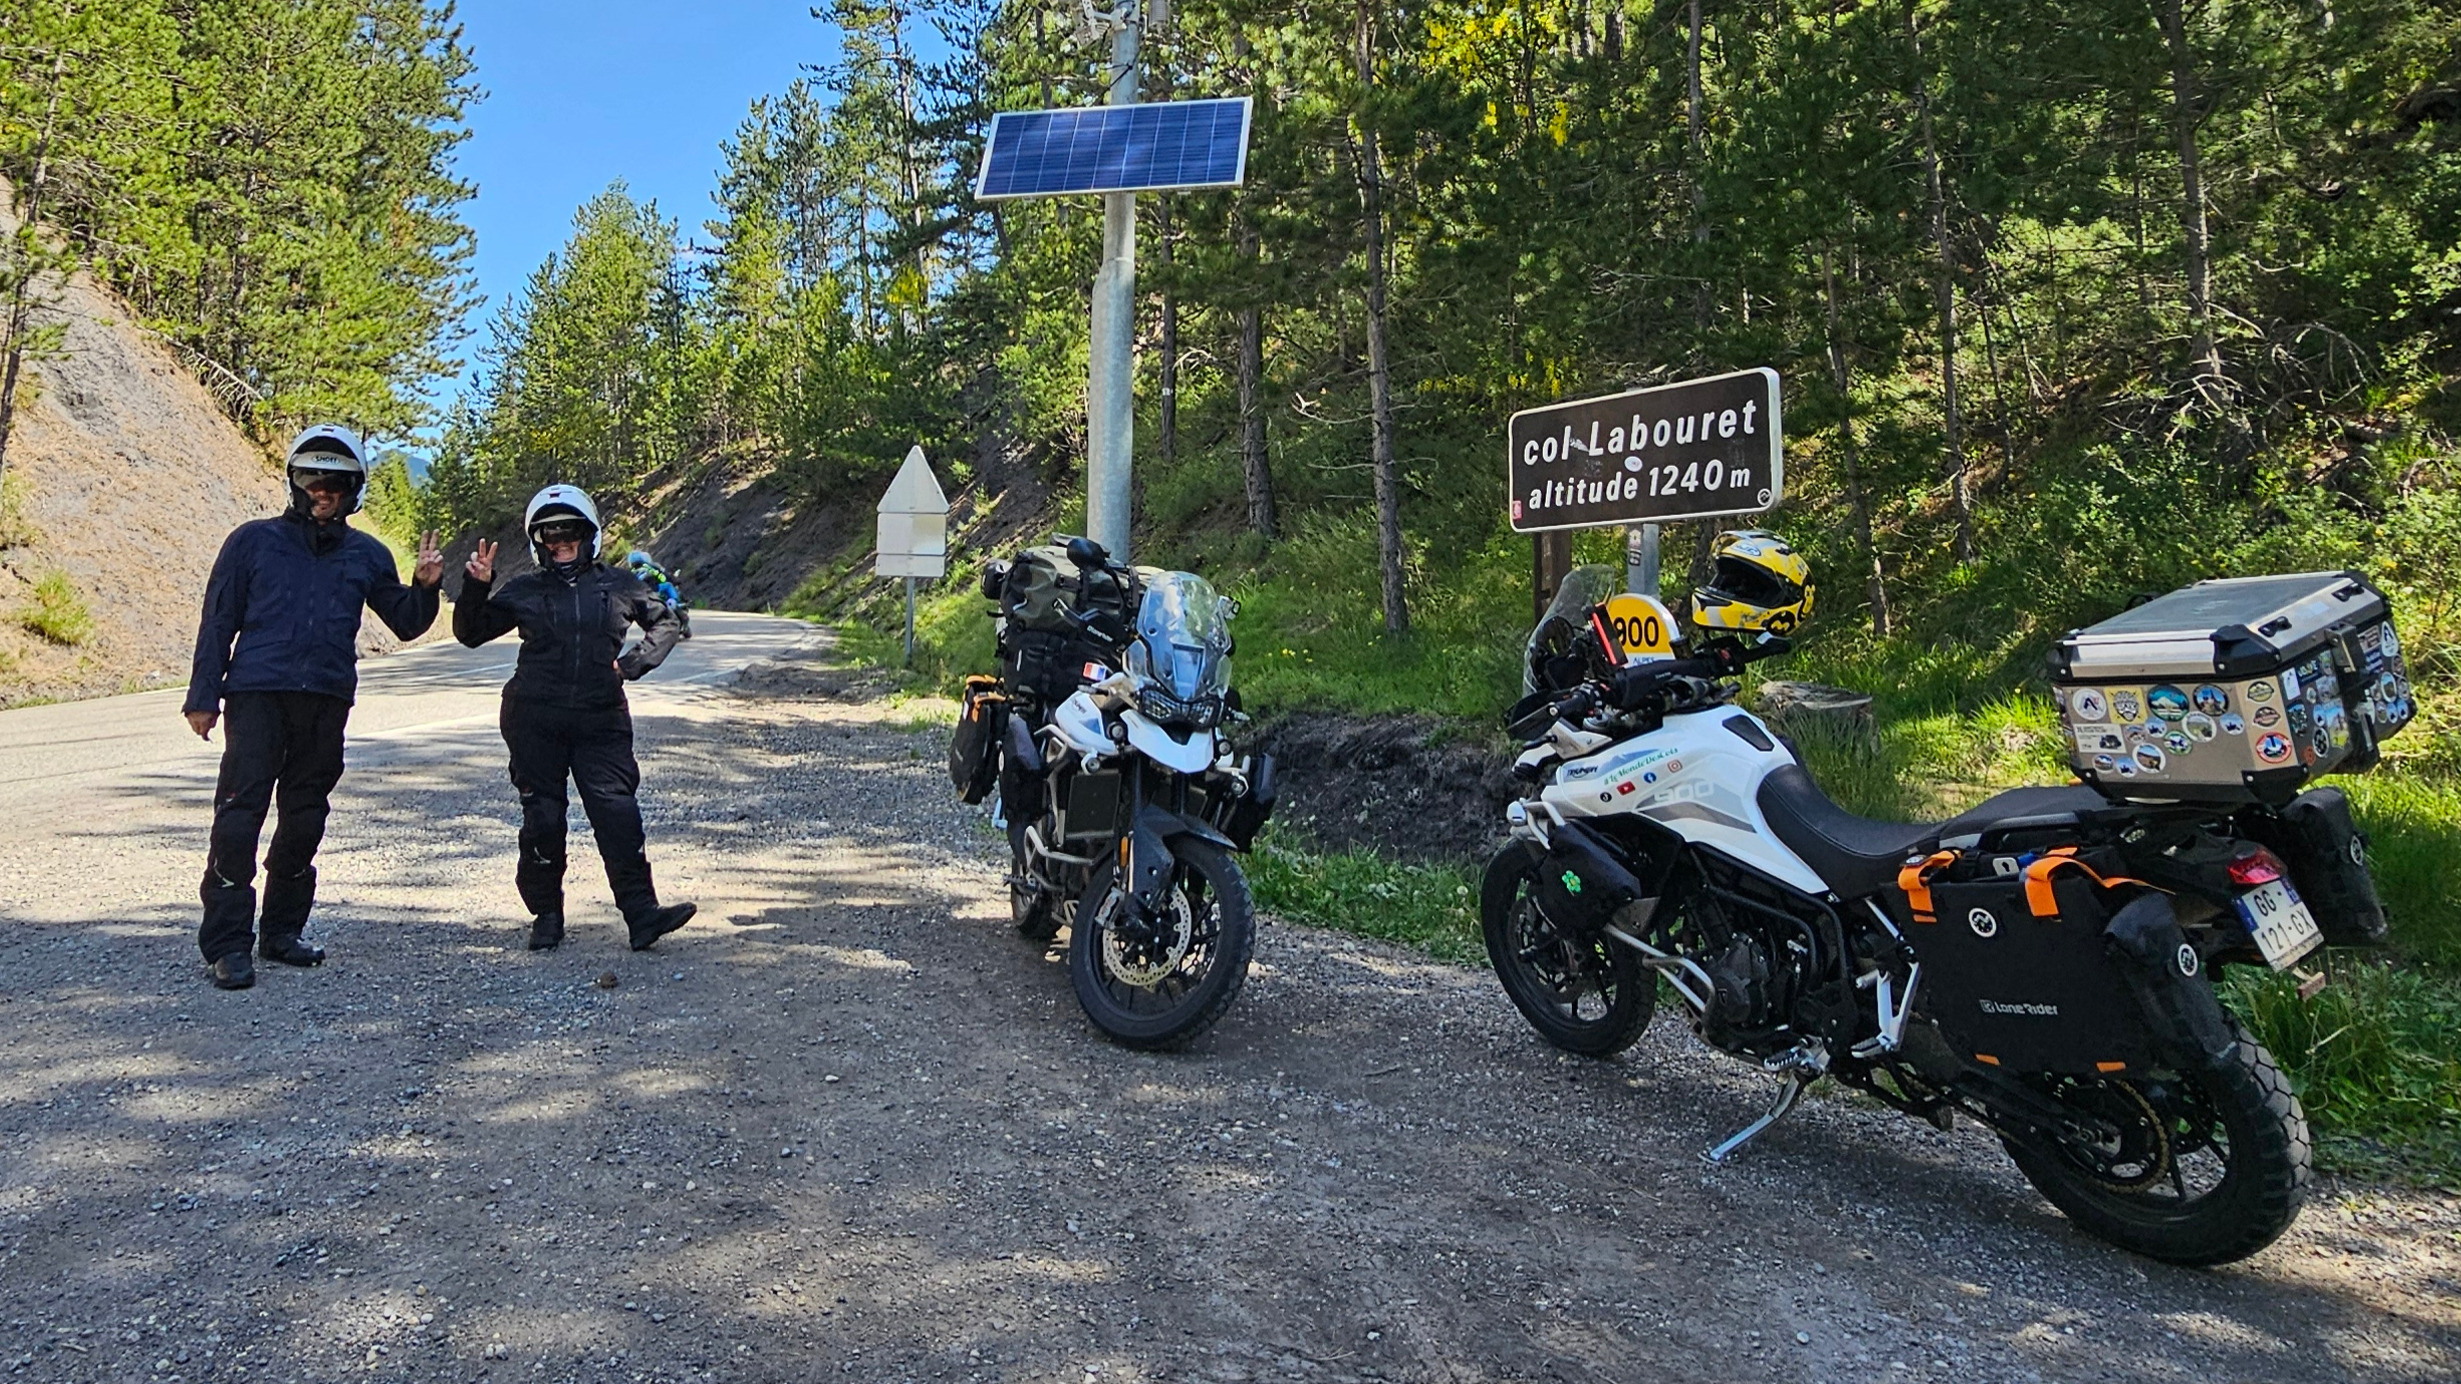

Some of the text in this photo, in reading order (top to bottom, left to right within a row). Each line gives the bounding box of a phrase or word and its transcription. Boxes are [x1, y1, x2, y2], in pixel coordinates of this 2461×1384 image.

[1523, 400, 1757, 466] col Labouret
[1529, 471, 1638, 510] altitude
[1649, 459, 1724, 497] 1240
[1730, 468, 1751, 488] m
[1613, 616, 1659, 648] 900
[1654, 780, 1715, 802] 900
[2261, 908, 2313, 954] 121-GX
